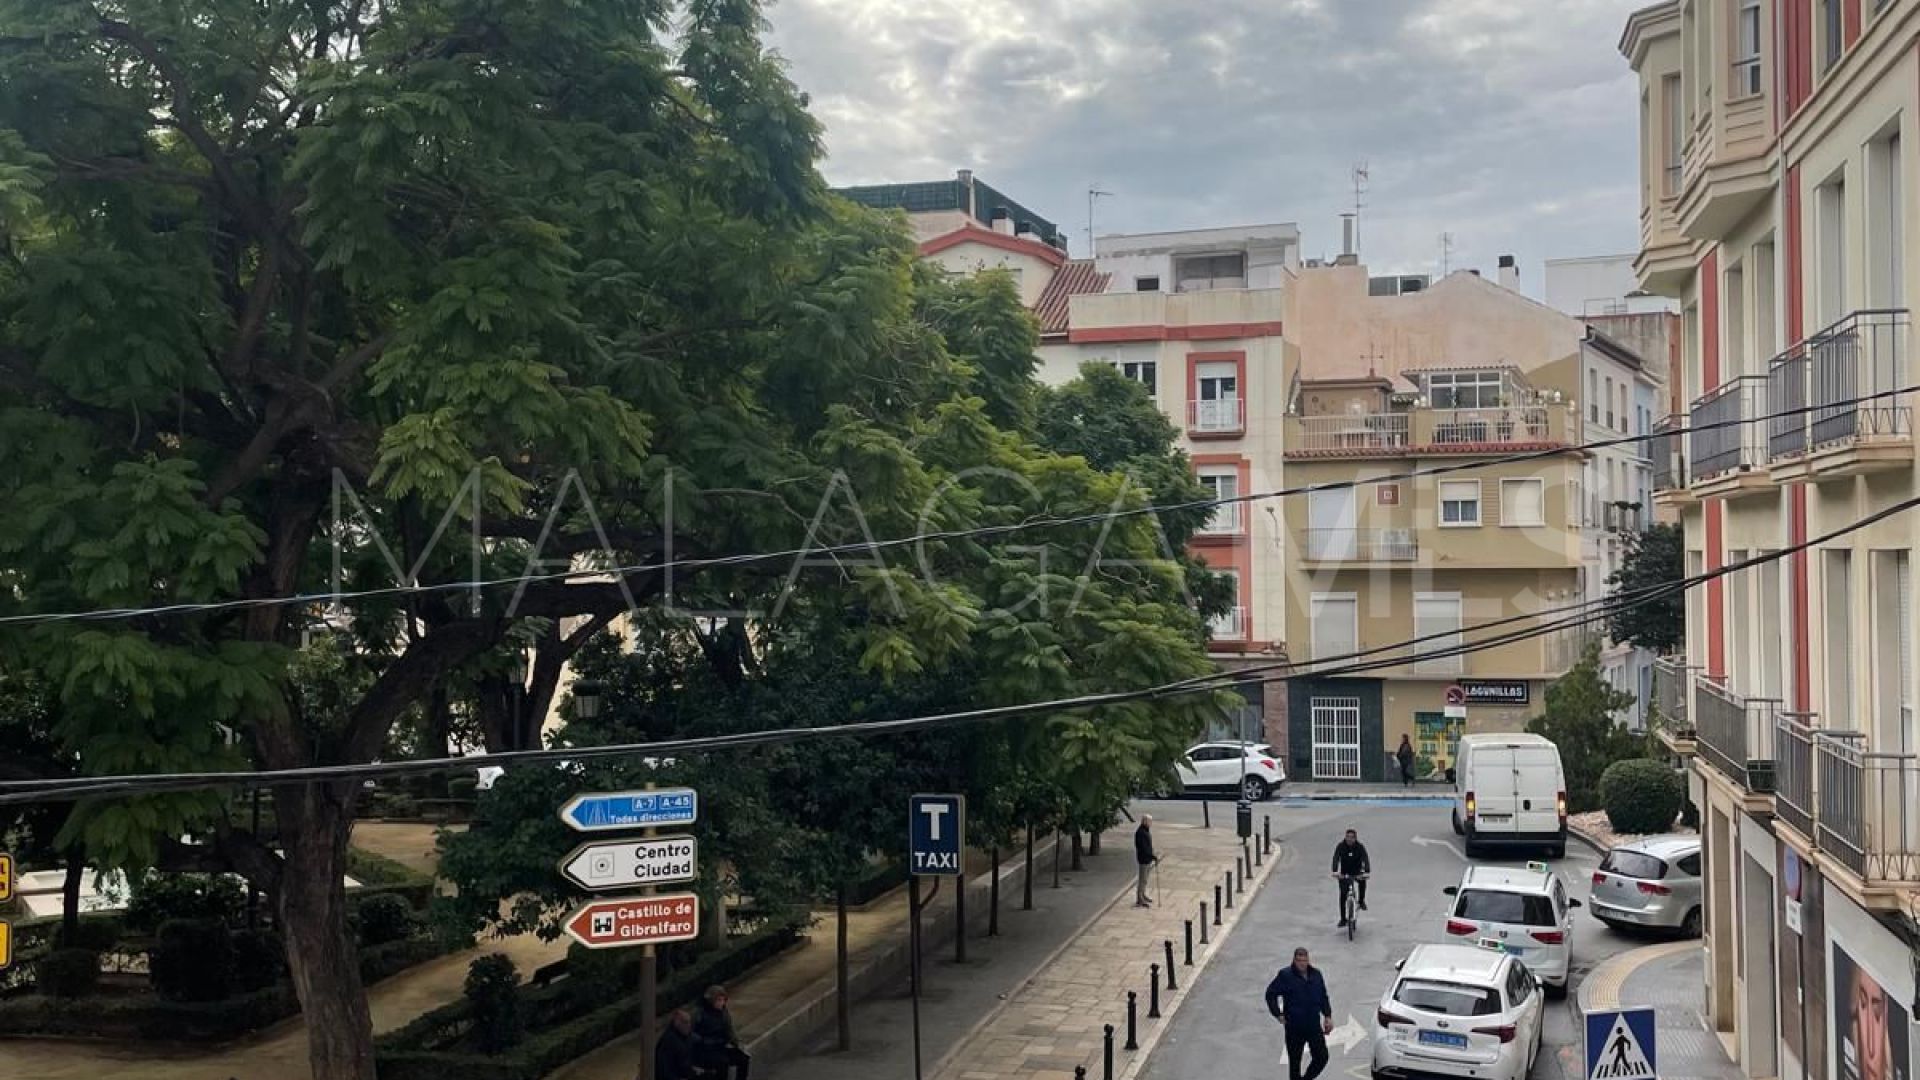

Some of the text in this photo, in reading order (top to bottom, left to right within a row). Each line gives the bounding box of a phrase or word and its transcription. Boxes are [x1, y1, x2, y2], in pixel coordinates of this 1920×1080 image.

[1465, 686, 1523, 697] LAGUNILLAS
[635, 796, 690, 810] A-7 A-45
[610, 811, 692, 824] Todas direcciones
[920, 803, 949, 841] T
[634, 844, 691, 860] Centro
[914, 851, 958, 870] TAXI
[634, 860, 691, 878] Ciudad
[617, 902, 692, 920] Castillo de
[620, 920, 691, 938] Gibralfaro
